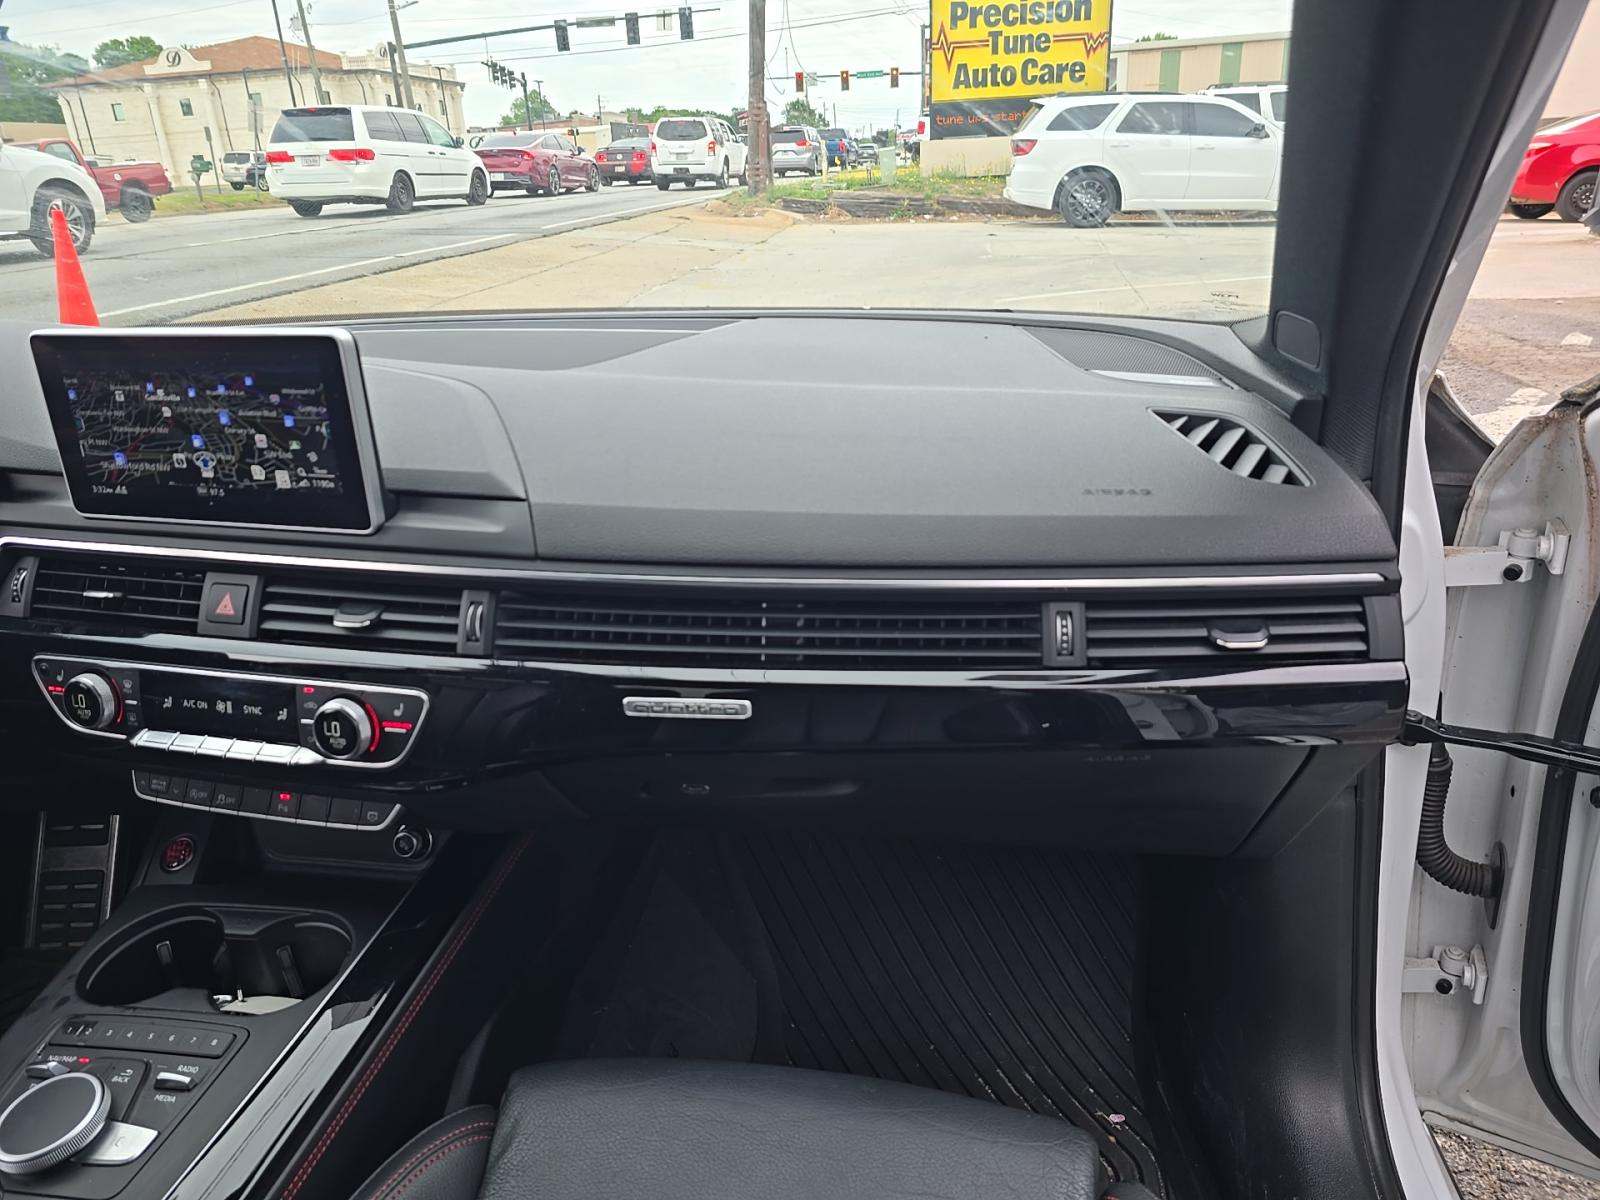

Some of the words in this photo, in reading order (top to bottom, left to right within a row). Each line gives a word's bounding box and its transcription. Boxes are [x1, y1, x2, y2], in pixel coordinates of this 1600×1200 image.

[950, 0, 1092, 30] Precision
[988, 30, 1051, 55] Tune
[953, 63, 1016, 89] Auto
[1021, 58, 1086, 86] Care
[936, 113, 963, 125] tune
[71, 694, 86, 708] LO
[183, 699, 196, 709] A/C
[197, 700, 208, 709] ON
[243, 704, 263, 715] SYNC
[323, 721, 341, 737] LO
[85, 1027, 93, 1035] 2
[106, 1029, 113, 1037] 3
[126, 1030, 134, 1038] 4
[147, 1032, 155, 1040] 5
[168, 1034, 176, 1042] 6
[189, 1035, 198, 1043] 7
[211, 1038, 218, 1046] 8
[177, 1065, 199, 1073] RADIO
[111, 1075, 129, 1083] BACK
[154, 1094, 176, 1103] MEDIA
